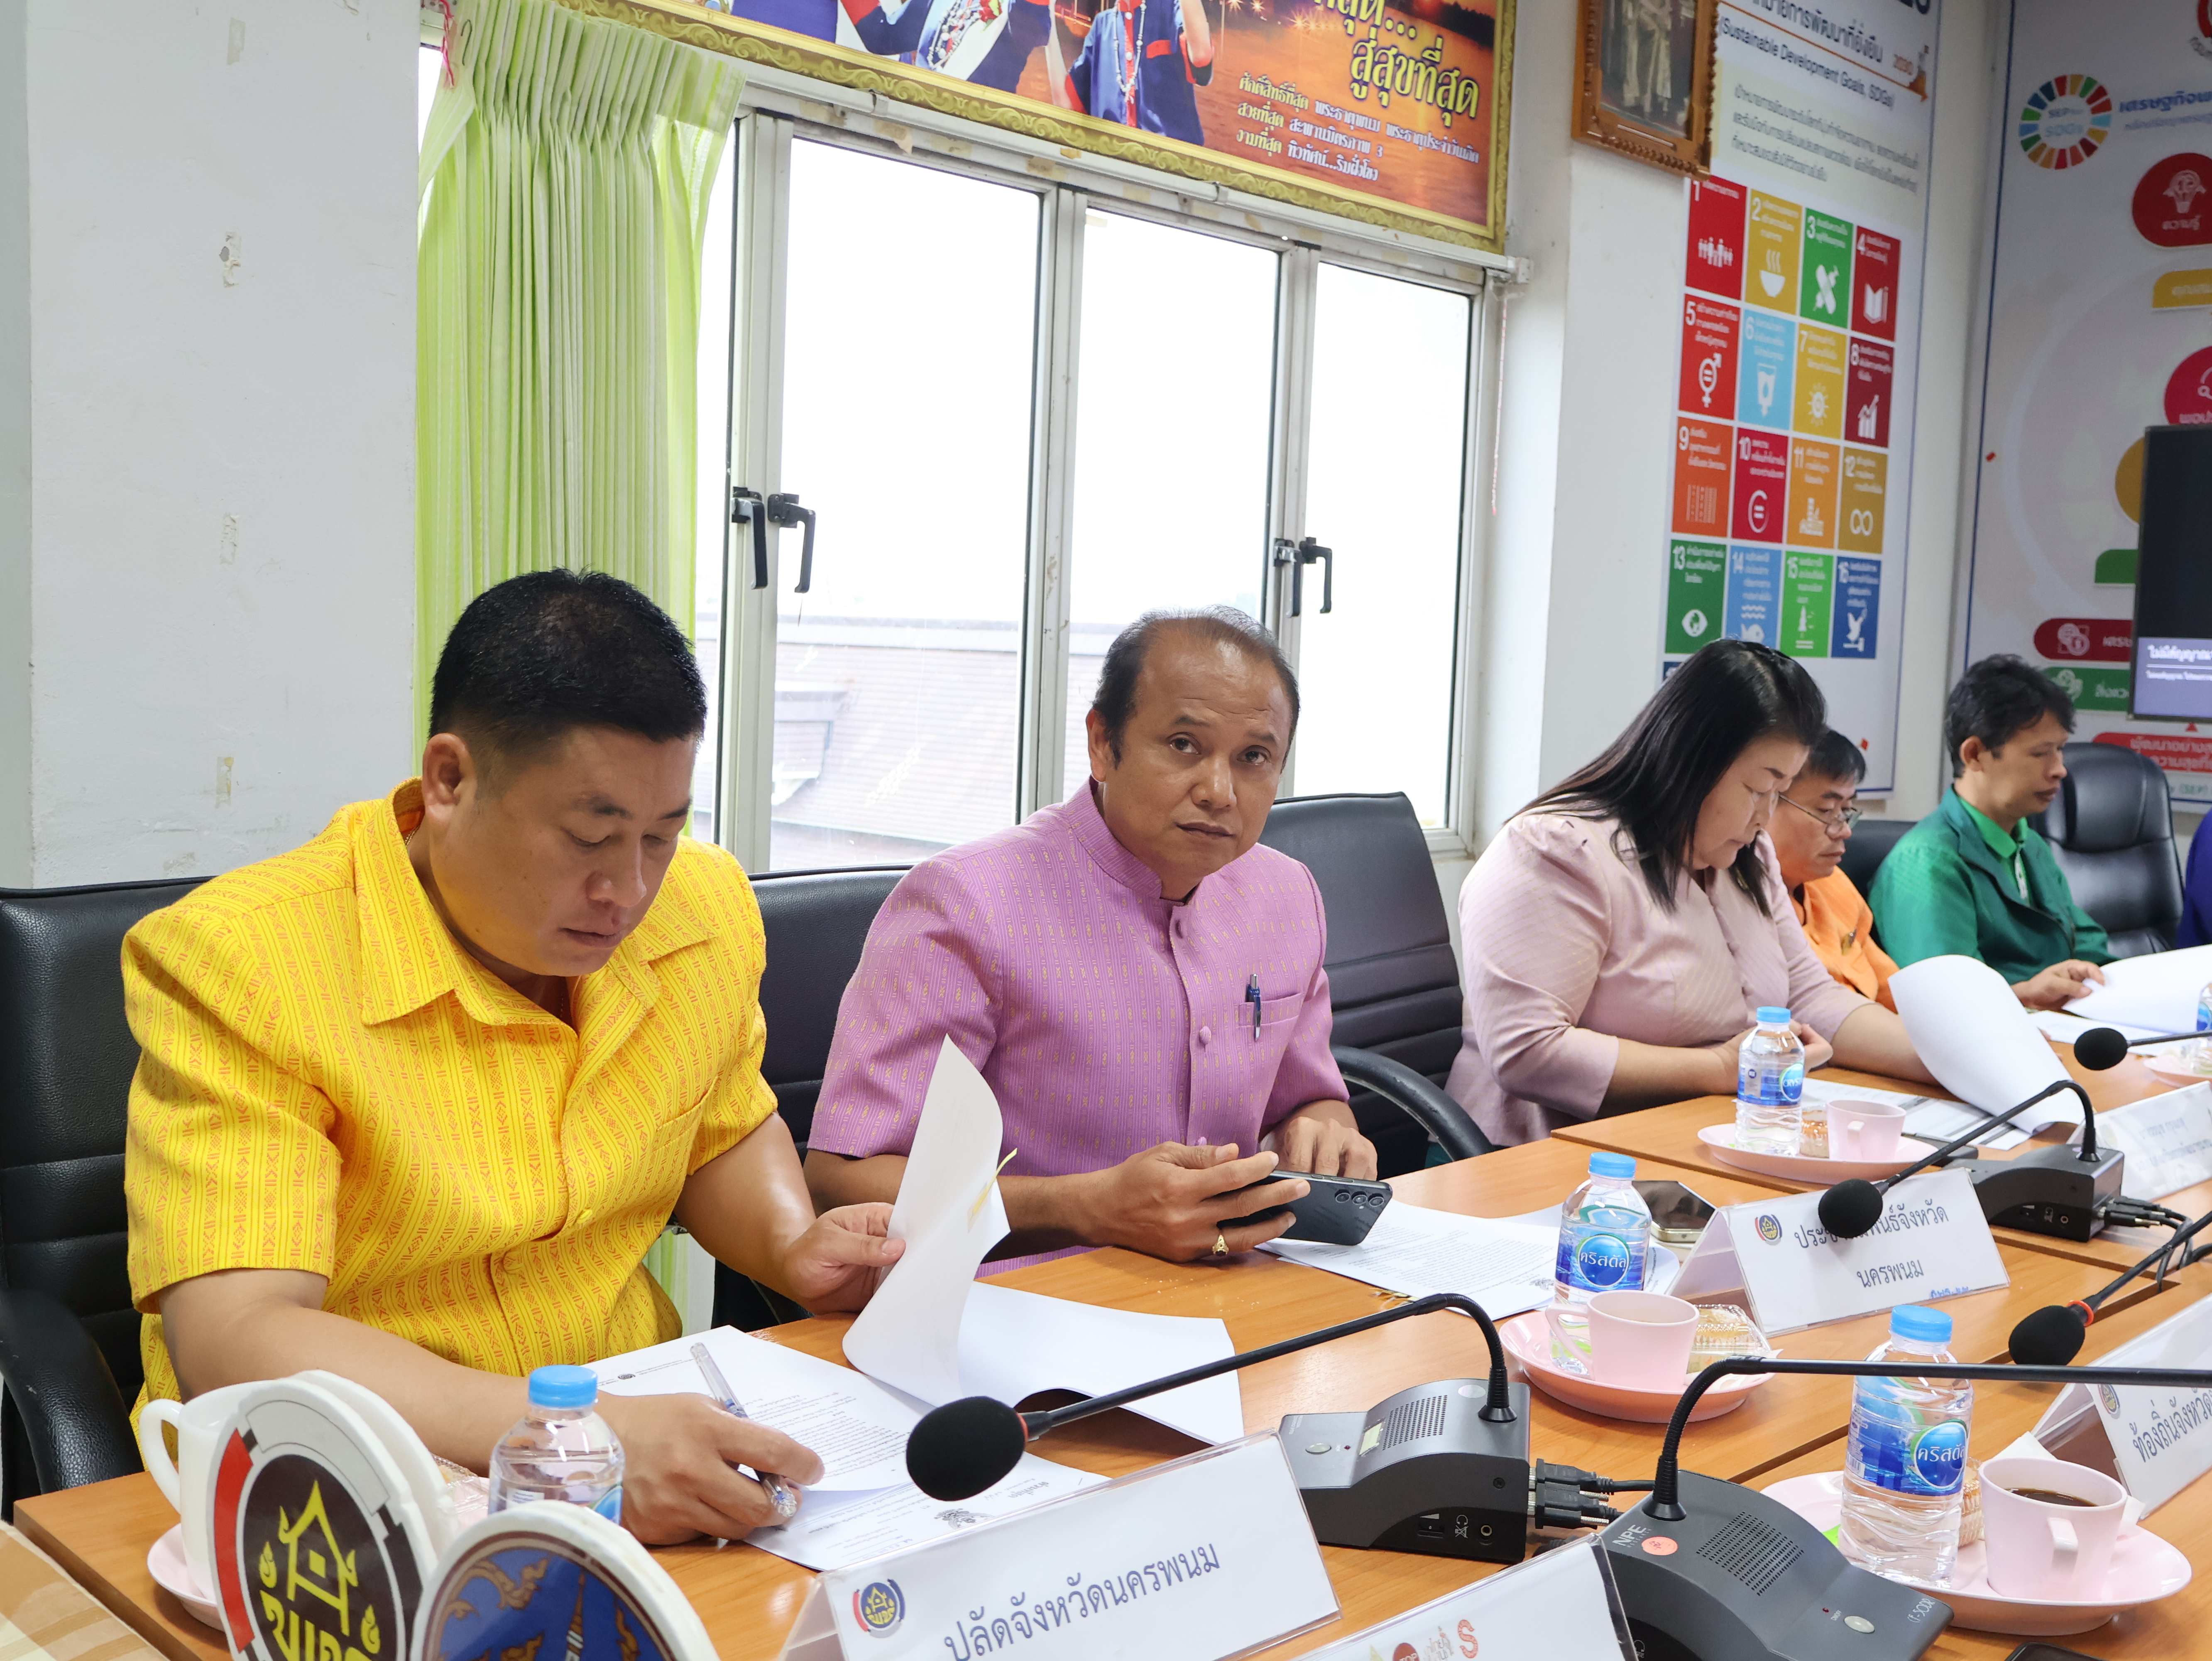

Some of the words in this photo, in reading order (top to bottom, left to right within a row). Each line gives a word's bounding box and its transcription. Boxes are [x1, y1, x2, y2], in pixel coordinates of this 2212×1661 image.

[1350, 26, 1479, 127] สู่สุขที่สุด
[1315, 100, 1381, 132] พระธาตุพนม
[1237, 101, 1285, 131] สวยที่สุด
[1289, 118, 1371, 154] สะพานมิตรภาพ
[1376, 145, 1383, 158] 3
[1236, 127, 1283, 157] งามที่สุด
[1693, 180, 1701, 201] 1
[1752, 197, 1762, 221] 2
[1807, 216, 1816, 239] 3
[1857, 233, 1866, 255] 4
[1686, 301, 1696, 326] 5
[1745, 316, 1754, 340] 6
[1800, 330, 1808, 352] 7
[1850, 343, 1860, 366] 8
[1580, 1251, 1626, 1268] คริสตัล
[1857, 1259, 1924, 1288] นครพนม
[1612, 1524, 1647, 1546] NPE
[944, 1543, 1221, 1661] ปลัดจังหวัดนครพนม
